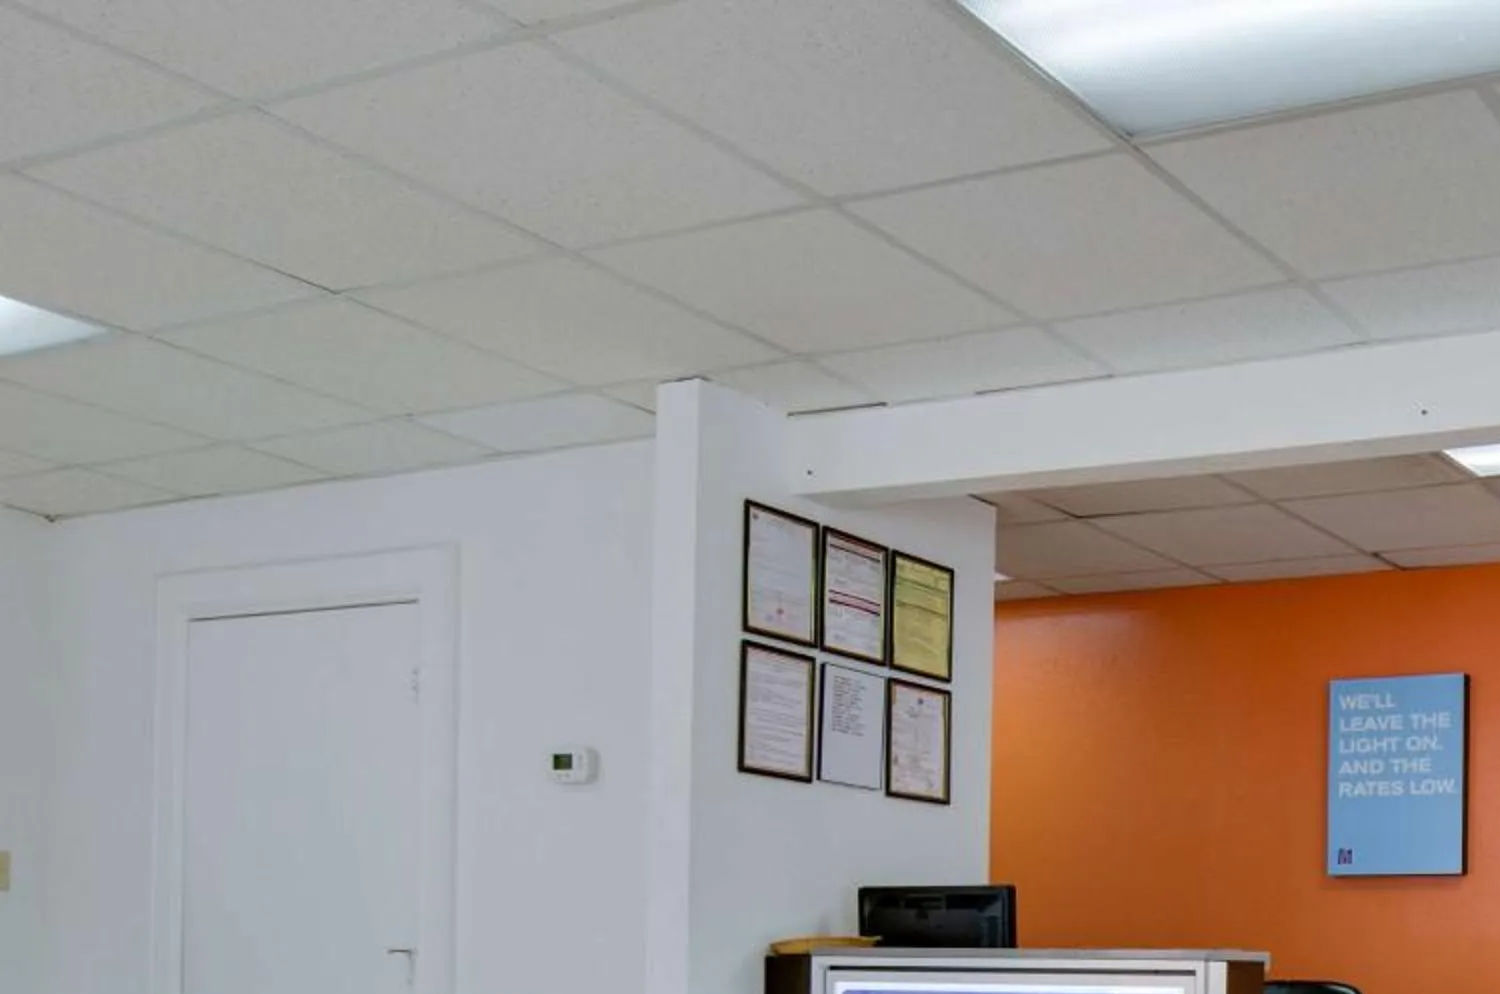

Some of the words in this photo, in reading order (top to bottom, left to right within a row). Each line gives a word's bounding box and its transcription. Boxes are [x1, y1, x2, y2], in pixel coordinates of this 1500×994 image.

[1339, 714, 1403, 732] LEAVE
[1410, 712, 1452, 729] THE
[1339, 736, 1402, 753] LIGHT
[1338, 759, 1383, 774] AND
[1391, 758, 1432, 773] THE
[1338, 780, 1403, 797] RATES
